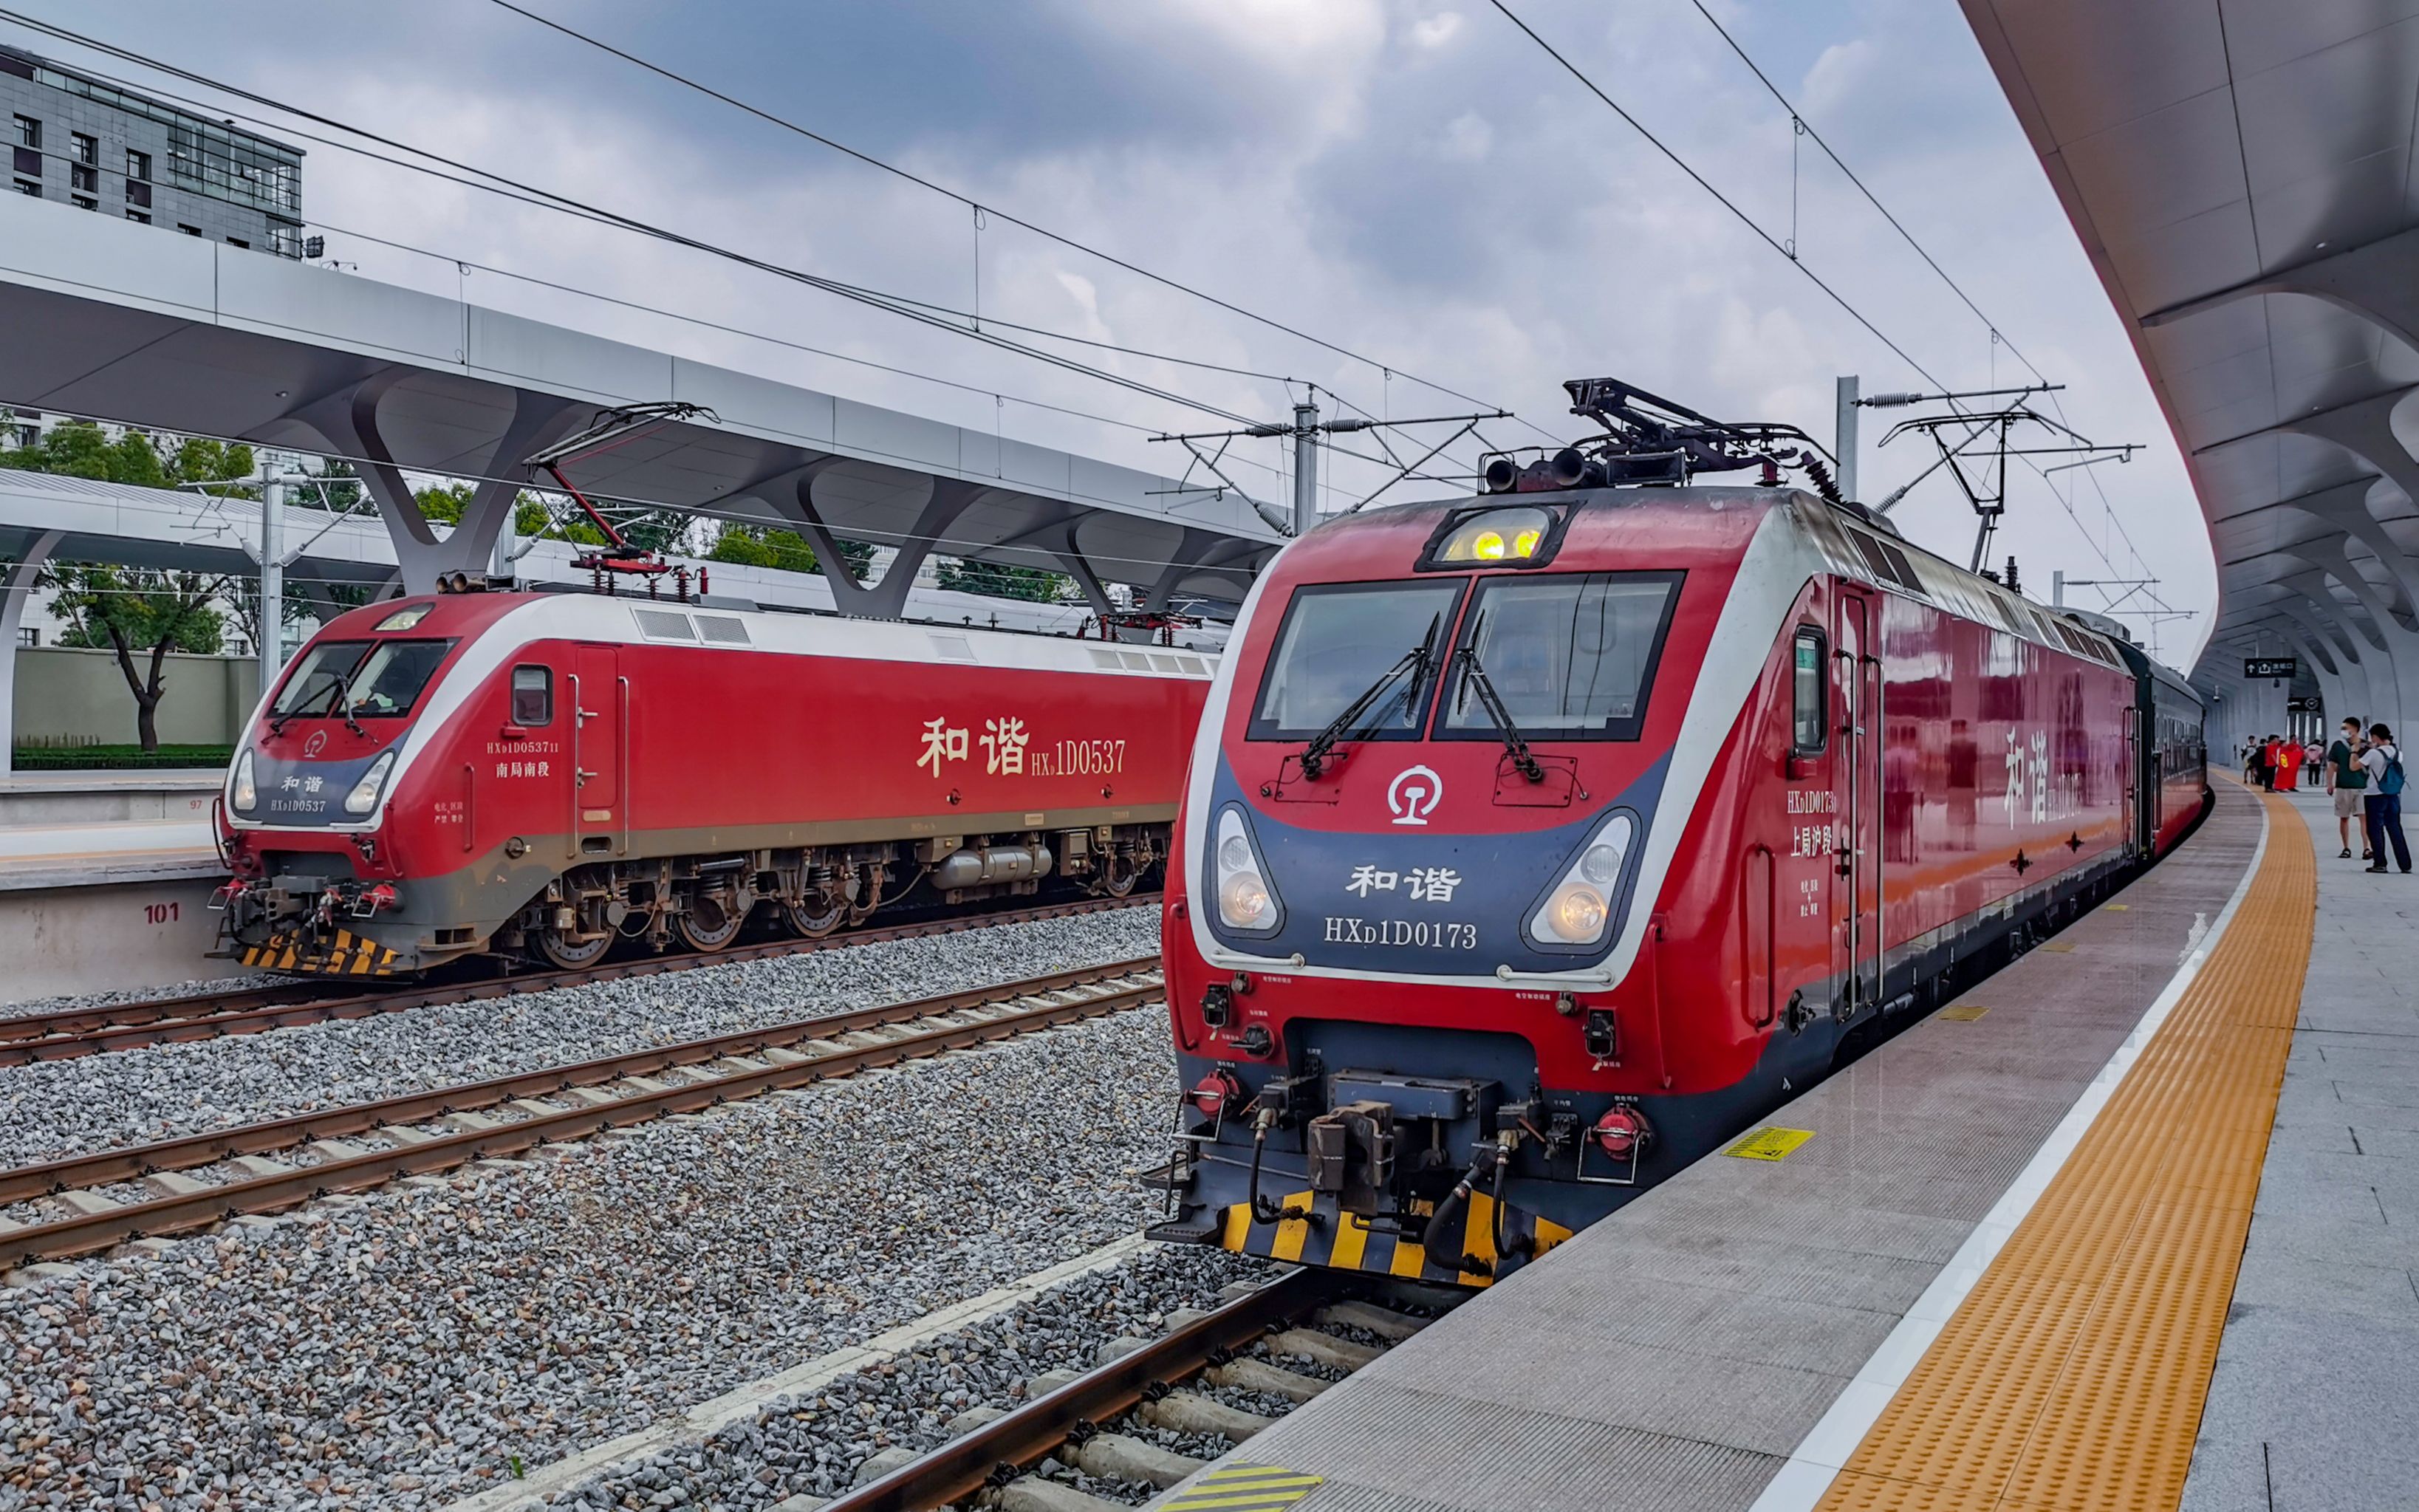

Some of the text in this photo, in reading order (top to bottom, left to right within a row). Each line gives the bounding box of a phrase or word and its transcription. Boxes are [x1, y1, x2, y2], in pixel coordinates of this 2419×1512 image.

[917, 716, 1030, 778] 和谐
[281, 776, 323, 793] 和谐
[496, 761, 550, 778] 南局南段
[2004, 725, 2047, 829] 和谐
[190, 800, 202, 810] 97
[1790, 825, 1833, 858] 上局沪段
[1345, 865, 1462, 902] 和谐
[144, 902, 179, 924] 101
[1324, 917, 1477, 949] HXD1D0173
